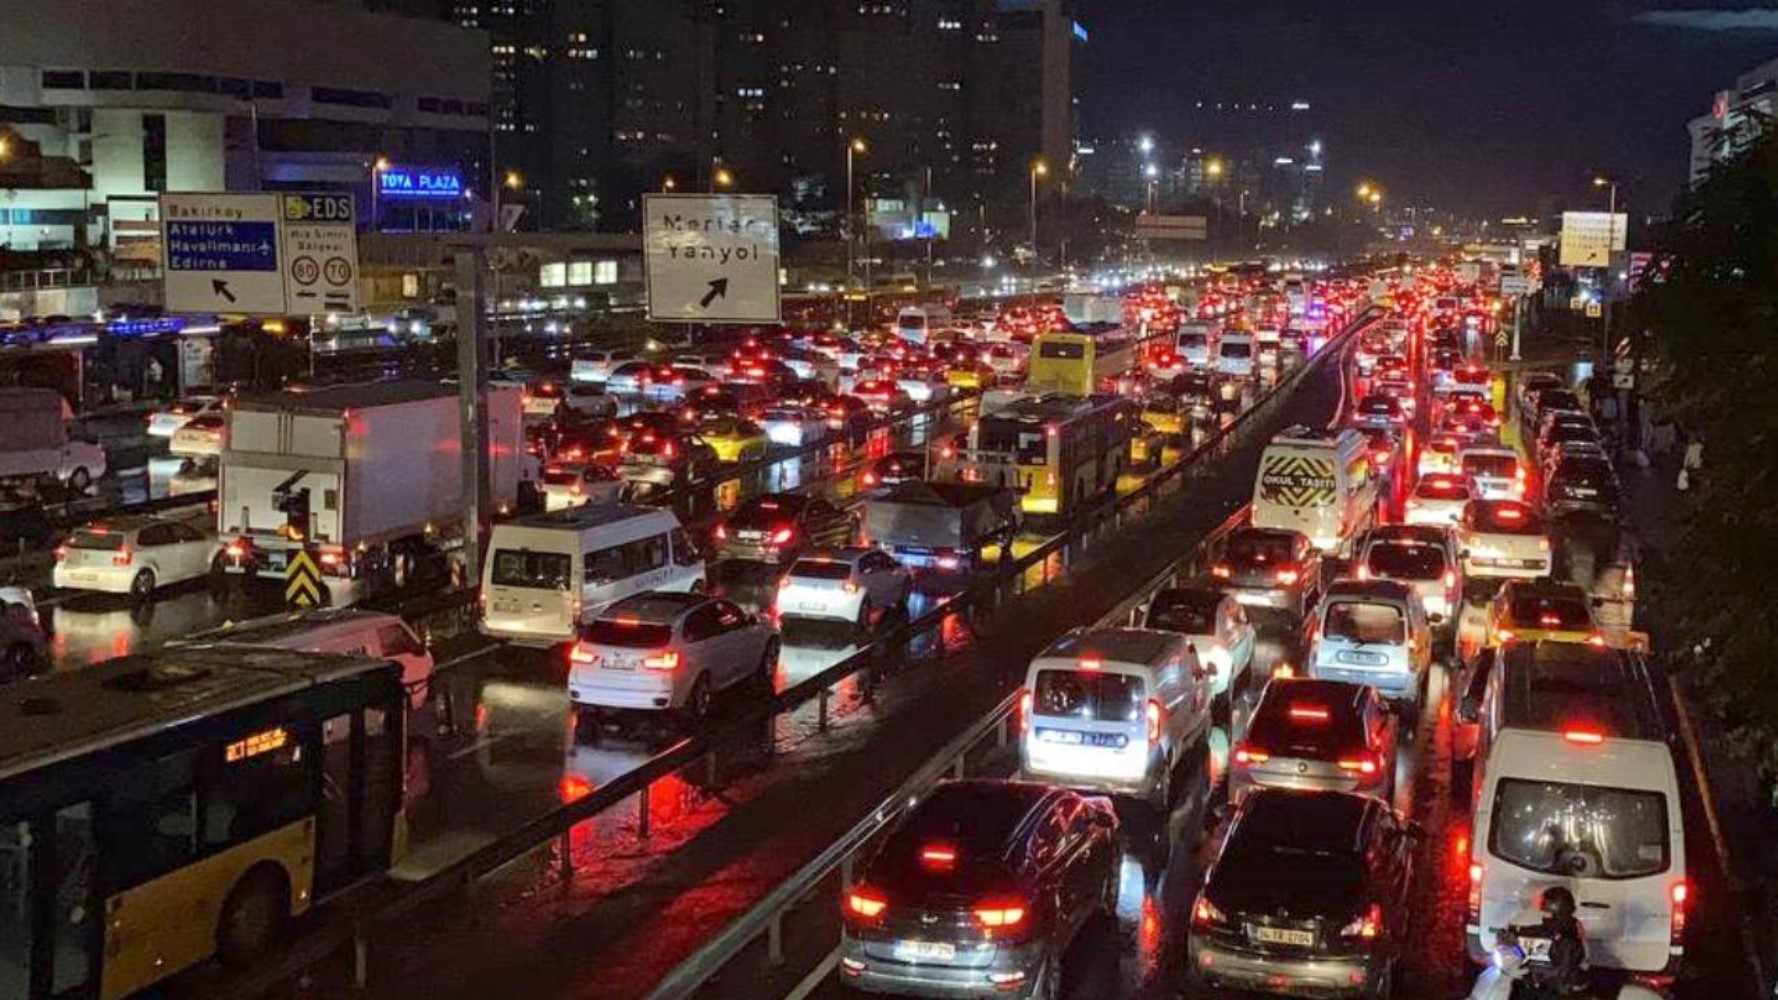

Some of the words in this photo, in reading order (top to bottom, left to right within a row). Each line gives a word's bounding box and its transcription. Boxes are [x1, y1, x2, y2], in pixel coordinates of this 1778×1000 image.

[381, 174, 412, 189] TOYA
[419, 175, 459, 190] PLAZA
[313, 197, 350, 219] EDS
[667, 241, 758, 265] Yanyol
[171, 256, 227, 269] Edirne
[330, 264, 347, 278] 70
[1263, 475, 1294, 486] OKUL
